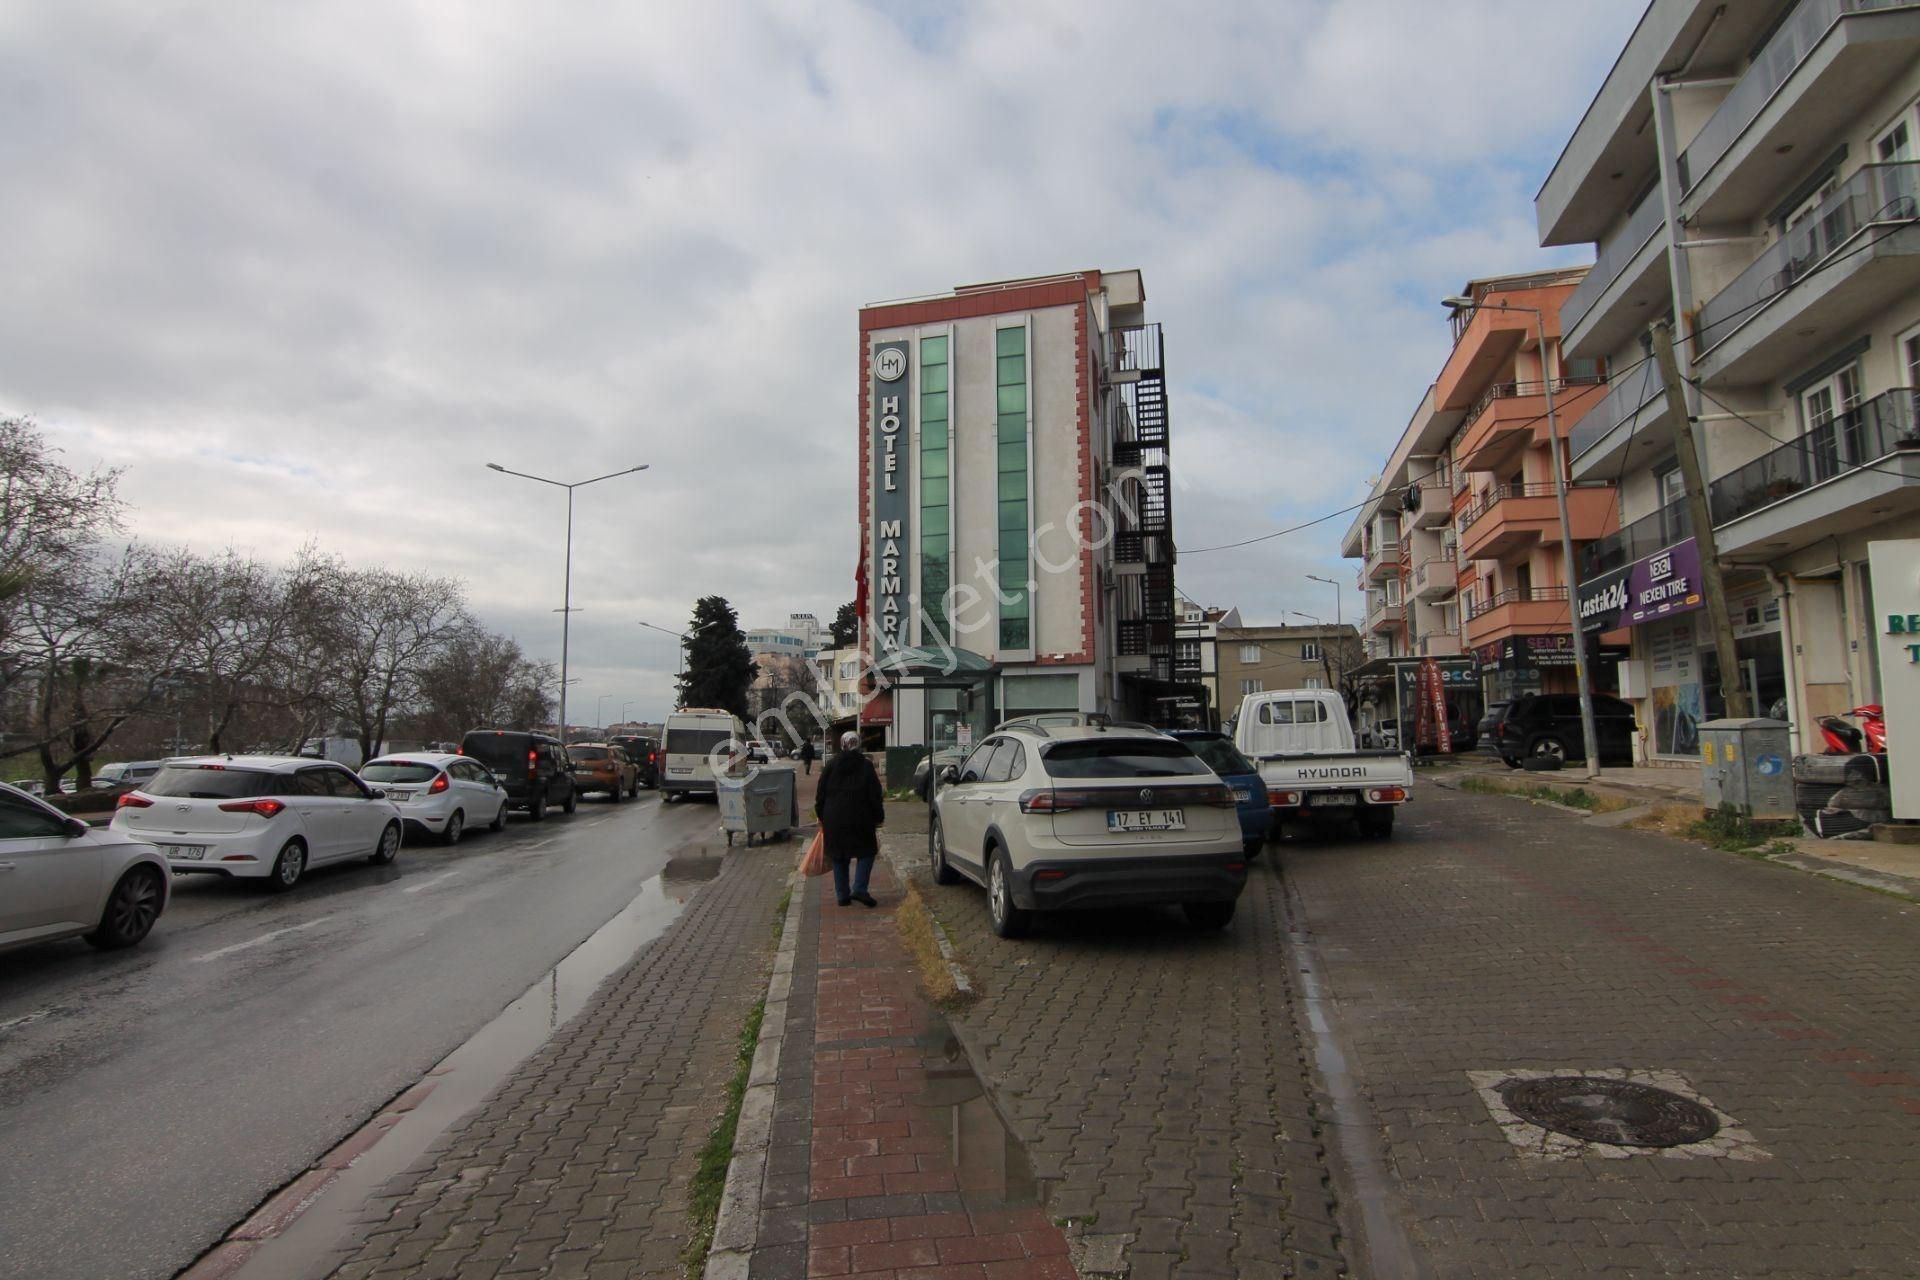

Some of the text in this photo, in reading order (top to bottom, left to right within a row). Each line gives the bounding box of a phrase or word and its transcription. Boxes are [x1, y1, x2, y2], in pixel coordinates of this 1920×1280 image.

[880, 396, 901, 651] HOTEL MARMARA
[1639, 584, 1668, 606] NEXEN
[1668, 577, 1688, 598] TIRE
[1298, 767, 1367, 779] HYUNDAI
[1116, 811, 1181, 826] 17 EY 141
